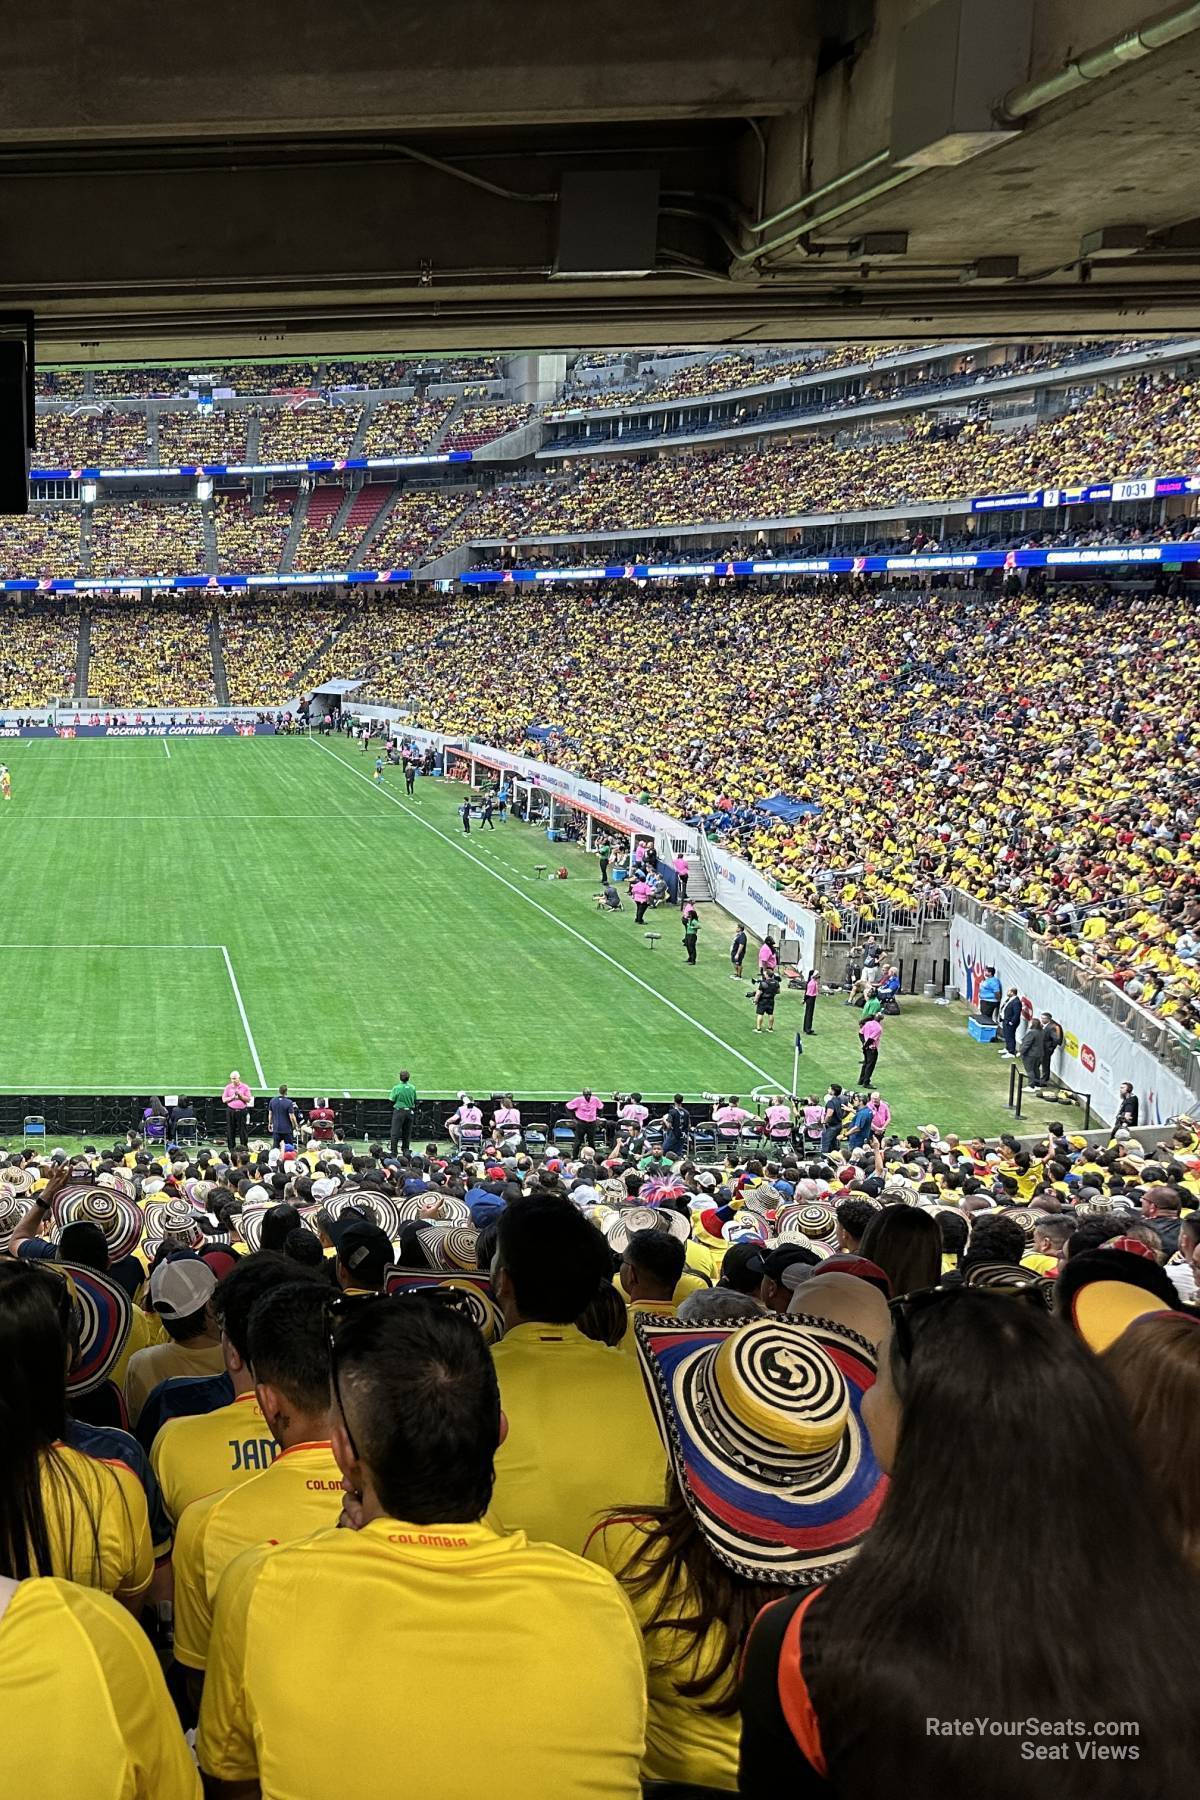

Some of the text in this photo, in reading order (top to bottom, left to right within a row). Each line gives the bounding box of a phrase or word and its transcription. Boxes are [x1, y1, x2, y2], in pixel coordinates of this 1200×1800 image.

[106, 726, 223, 736] ROCKING THE CONTINENT
[387, 1534, 469, 1548] COLOMBIA
